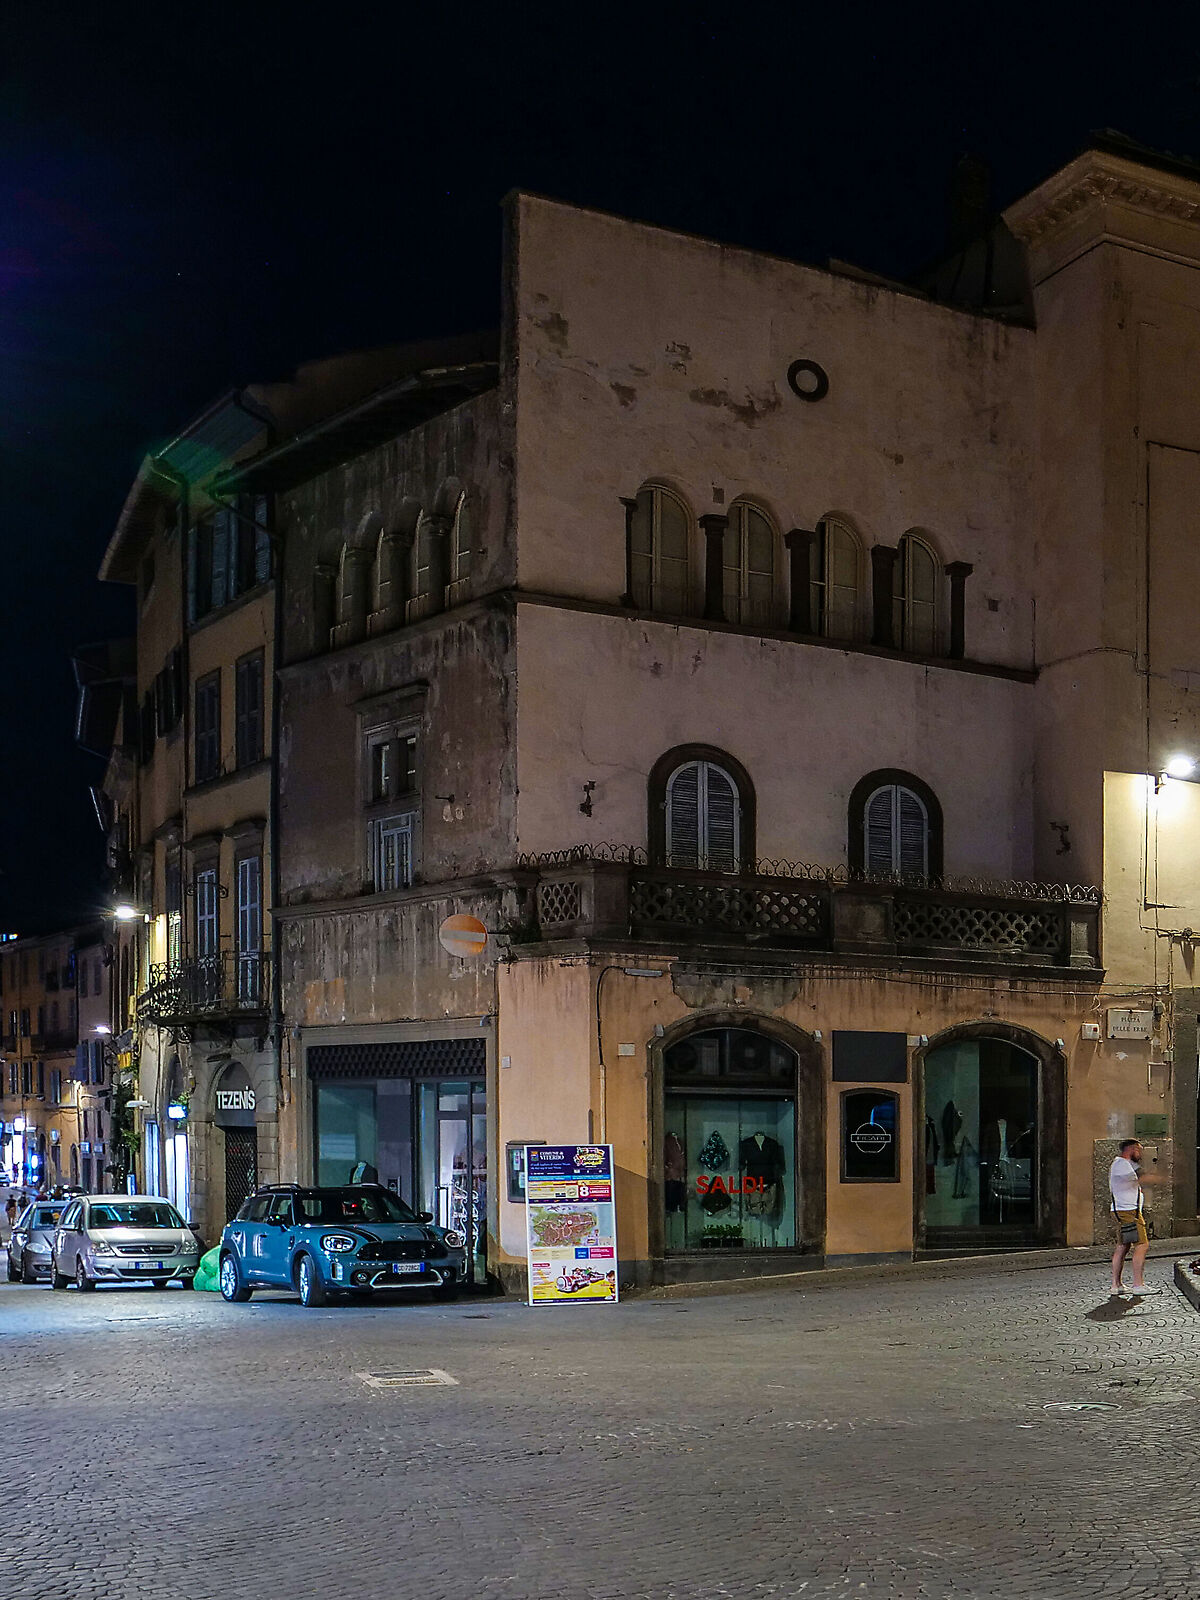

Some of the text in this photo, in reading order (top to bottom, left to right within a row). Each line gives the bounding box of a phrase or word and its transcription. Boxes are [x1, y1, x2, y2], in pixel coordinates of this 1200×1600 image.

[216, 1085, 256, 1110] TEZENIS
[579, 1186, 590, 1197] 8
[696, 1175, 766, 1195] SALDI
